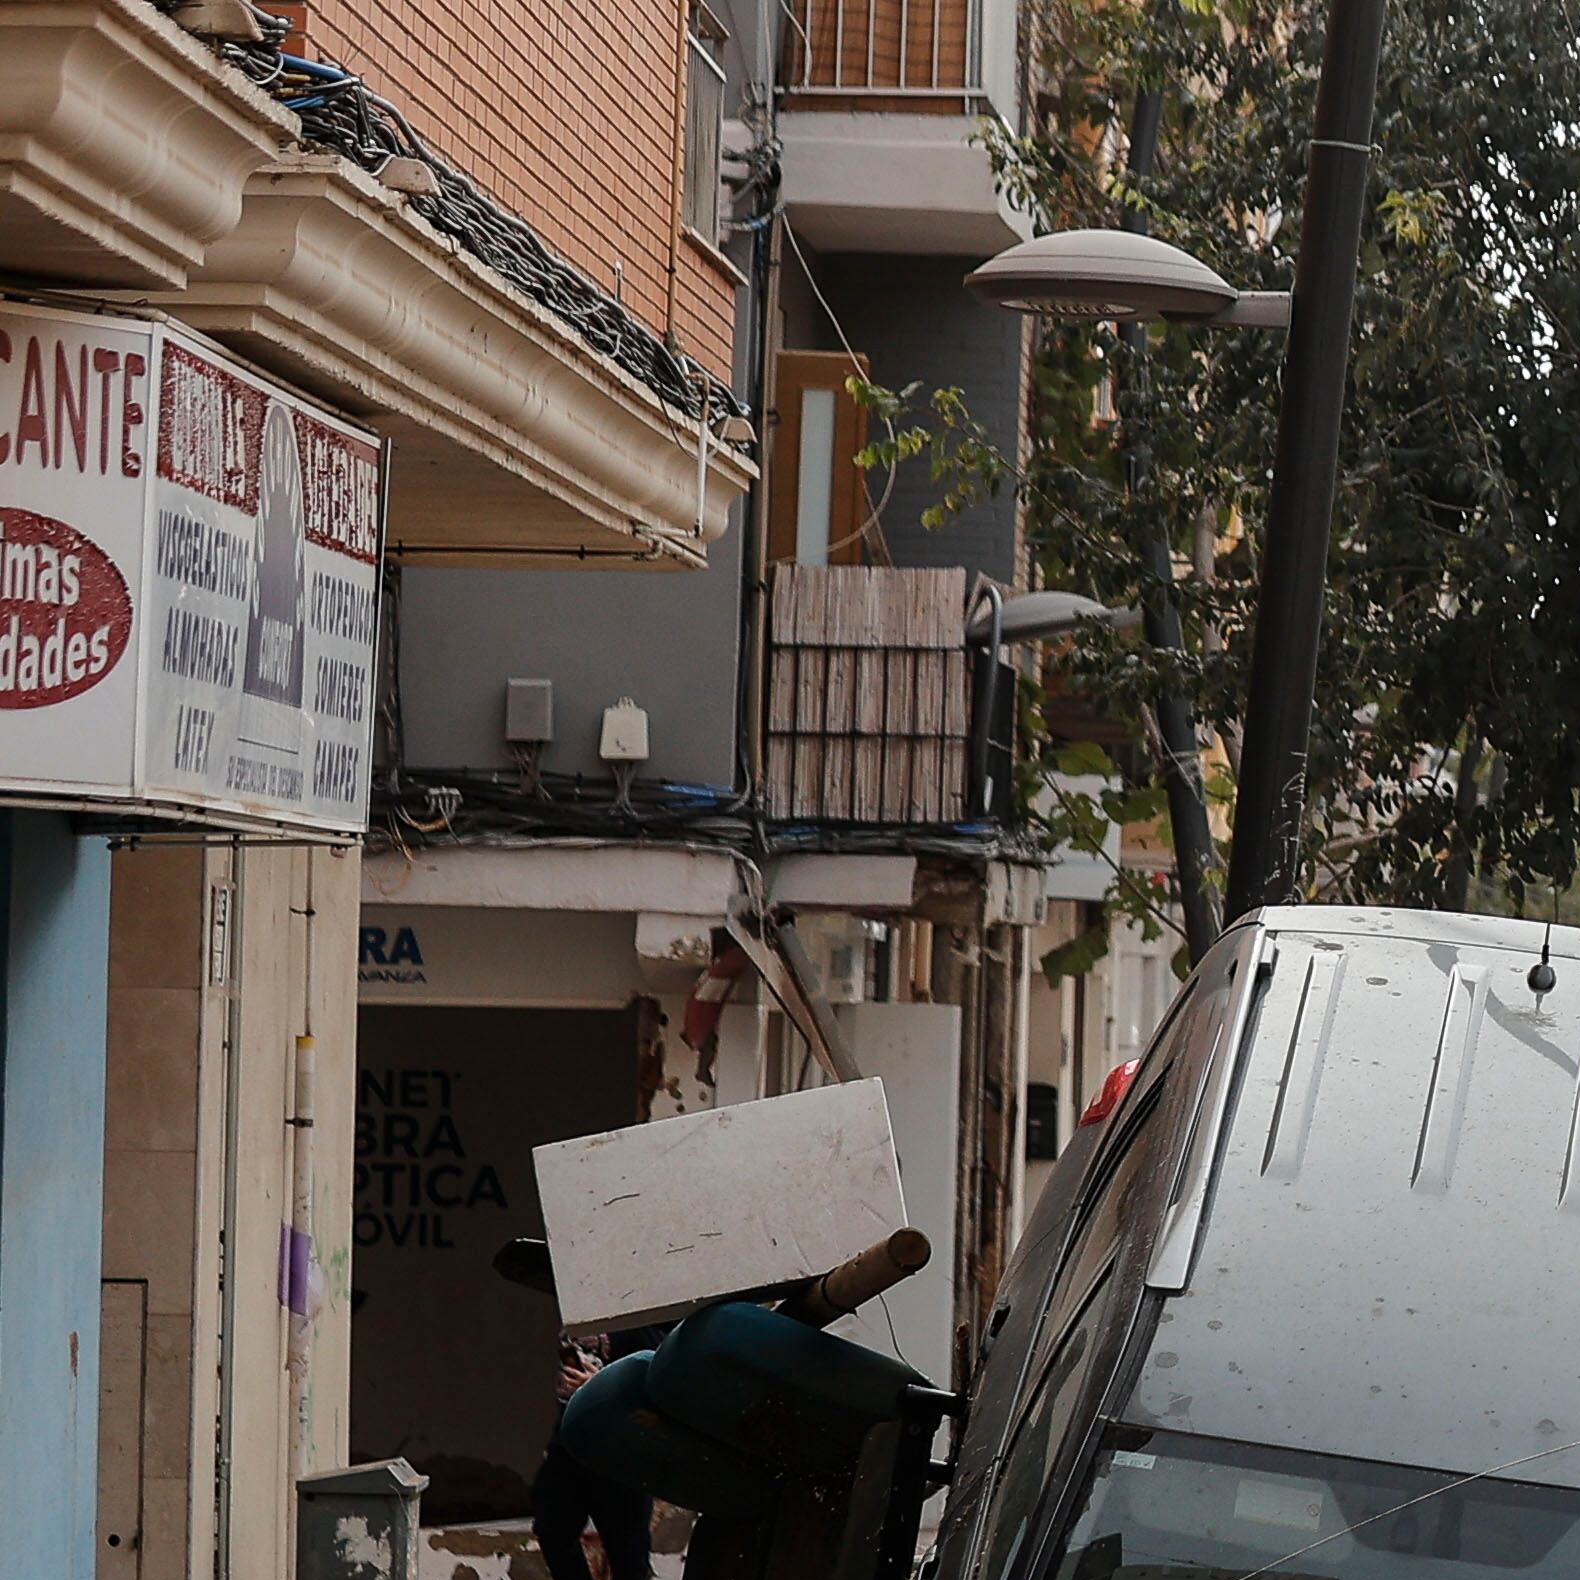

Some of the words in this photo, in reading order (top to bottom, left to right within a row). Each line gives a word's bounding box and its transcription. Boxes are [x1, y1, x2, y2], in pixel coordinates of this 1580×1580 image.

[0, 614, 110, 692] dades
[162, 605, 239, 689] ALMOHADAS
[174, 703, 215, 775] LATEX
